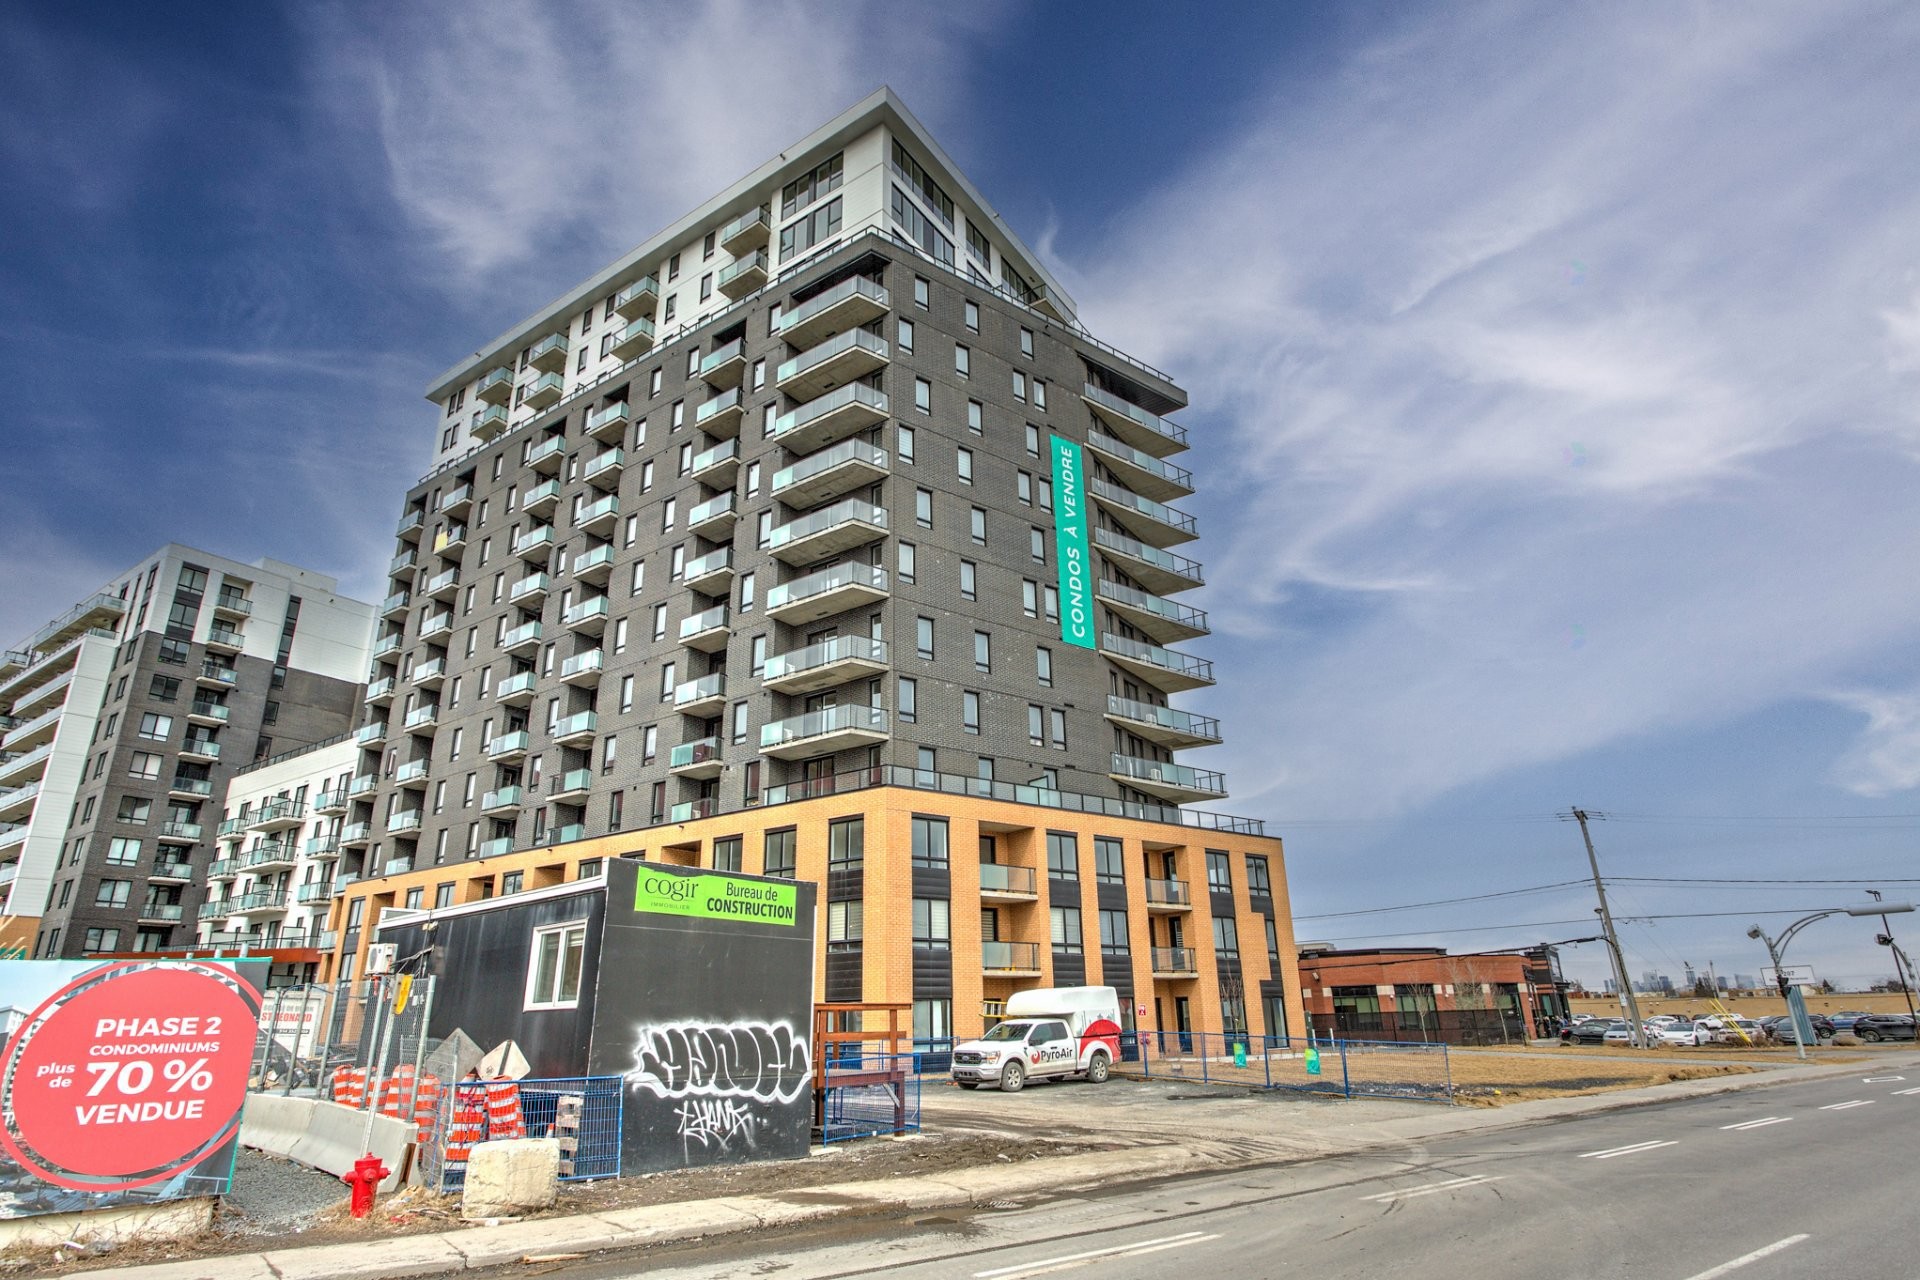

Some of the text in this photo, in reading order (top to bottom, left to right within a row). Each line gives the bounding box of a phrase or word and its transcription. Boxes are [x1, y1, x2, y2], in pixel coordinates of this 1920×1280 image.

[1060, 445, 1085, 638] CONDOS À VENDRE
[726, 881, 778, 901] Bureau de
[650, 901, 690, 910] IMMOBILIER
[706, 897, 793, 919] CONSTRUCTION
[95, 1016, 222, 1038] PHASE 2
[89, 1041, 220, 1056] CONDOMINIUMS
[1041, 1048, 1072, 1062] PyroAir
[36, 1062, 76, 1078] plus
[86, 1058, 213, 1097] 70 %
[49, 1076, 72, 1089] de
[75, 1099, 205, 1126] VENDUE
